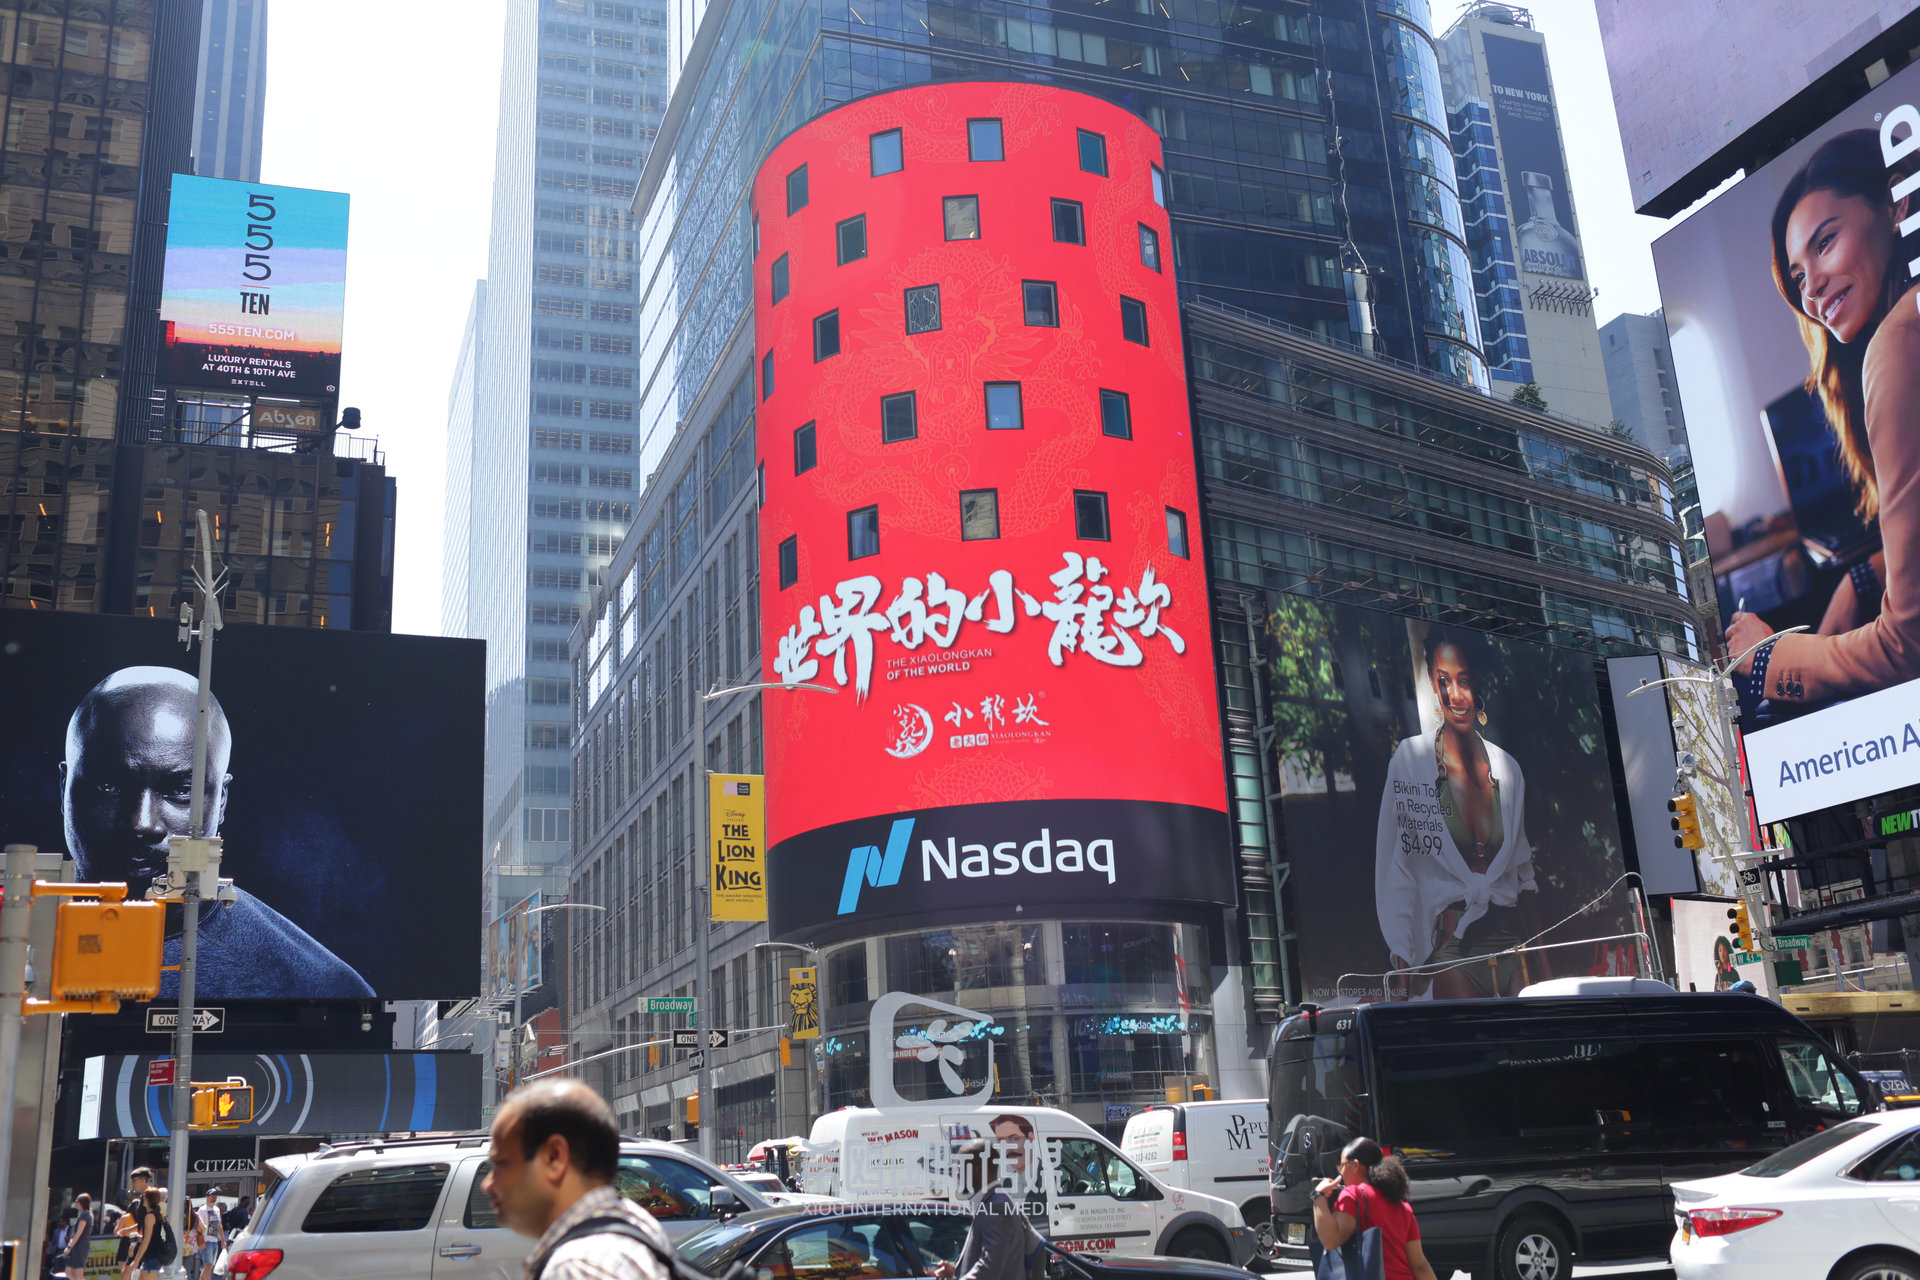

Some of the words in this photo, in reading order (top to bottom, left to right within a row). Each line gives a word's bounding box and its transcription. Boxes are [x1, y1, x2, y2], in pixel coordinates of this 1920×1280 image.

[1492, 84, 1504, 95] TO
[1505, 87, 1523, 98] NEW
[240, 292, 270, 315] TEN
[208, 323, 295, 341] 555TEN.COM
[208, 354, 247, 365] LUXURY
[249, 357, 291, 369] RENTALS
[202, 363, 214, 371] AT
[216, 364, 242, 375] 40TH
[243, 367, 250, 375] &
[253, 367, 275, 377] 10TH
[277, 370, 296, 379] AVE
[231, 378, 266, 387] EXTELL
[258, 409, 316, 428] Absen
[886, 657, 907, 669] THE
[910, 648, 993, 665] XIAOLONGKAN
[886, 670, 901, 681] OF
[904, 666, 925, 678] THE
[927, 661, 970, 674] WORLD
[990, 731, 1052, 741] XIAOLONGKAN
[1779, 740, 1898, 788] American
[1393, 780, 1420, 797] Bikini
[1422, 783, 1441, 801] Top
[1396, 797, 1405, 812] in
[1407, 799, 1452, 818] Recycled
[722, 824, 749, 837] THE
[1398, 814, 1444, 833] Materials
[1401, 831, 1443, 856] $4.99
[921, 828, 1116, 885] Nasdaq
[1777, 938, 1808, 948] Broadway
[1312, 988, 1330, 997] NOW
[1340, 988, 1367, 997] STORES
[1368, 989, 1382, 997] AND
[1389, 989, 1408, 998] NLINE
[650, 1000, 693, 1012] Broadway
[158, 1016, 179, 1025] ONE
[1336, 1019, 1352, 1030] 631
[681, 1035, 697, 1043] ONE
[1880, 1079, 1910, 1091] OZEN
[885, 1130, 919, 1143] MASON
[193, 1158, 257, 1172] CITIZEN
